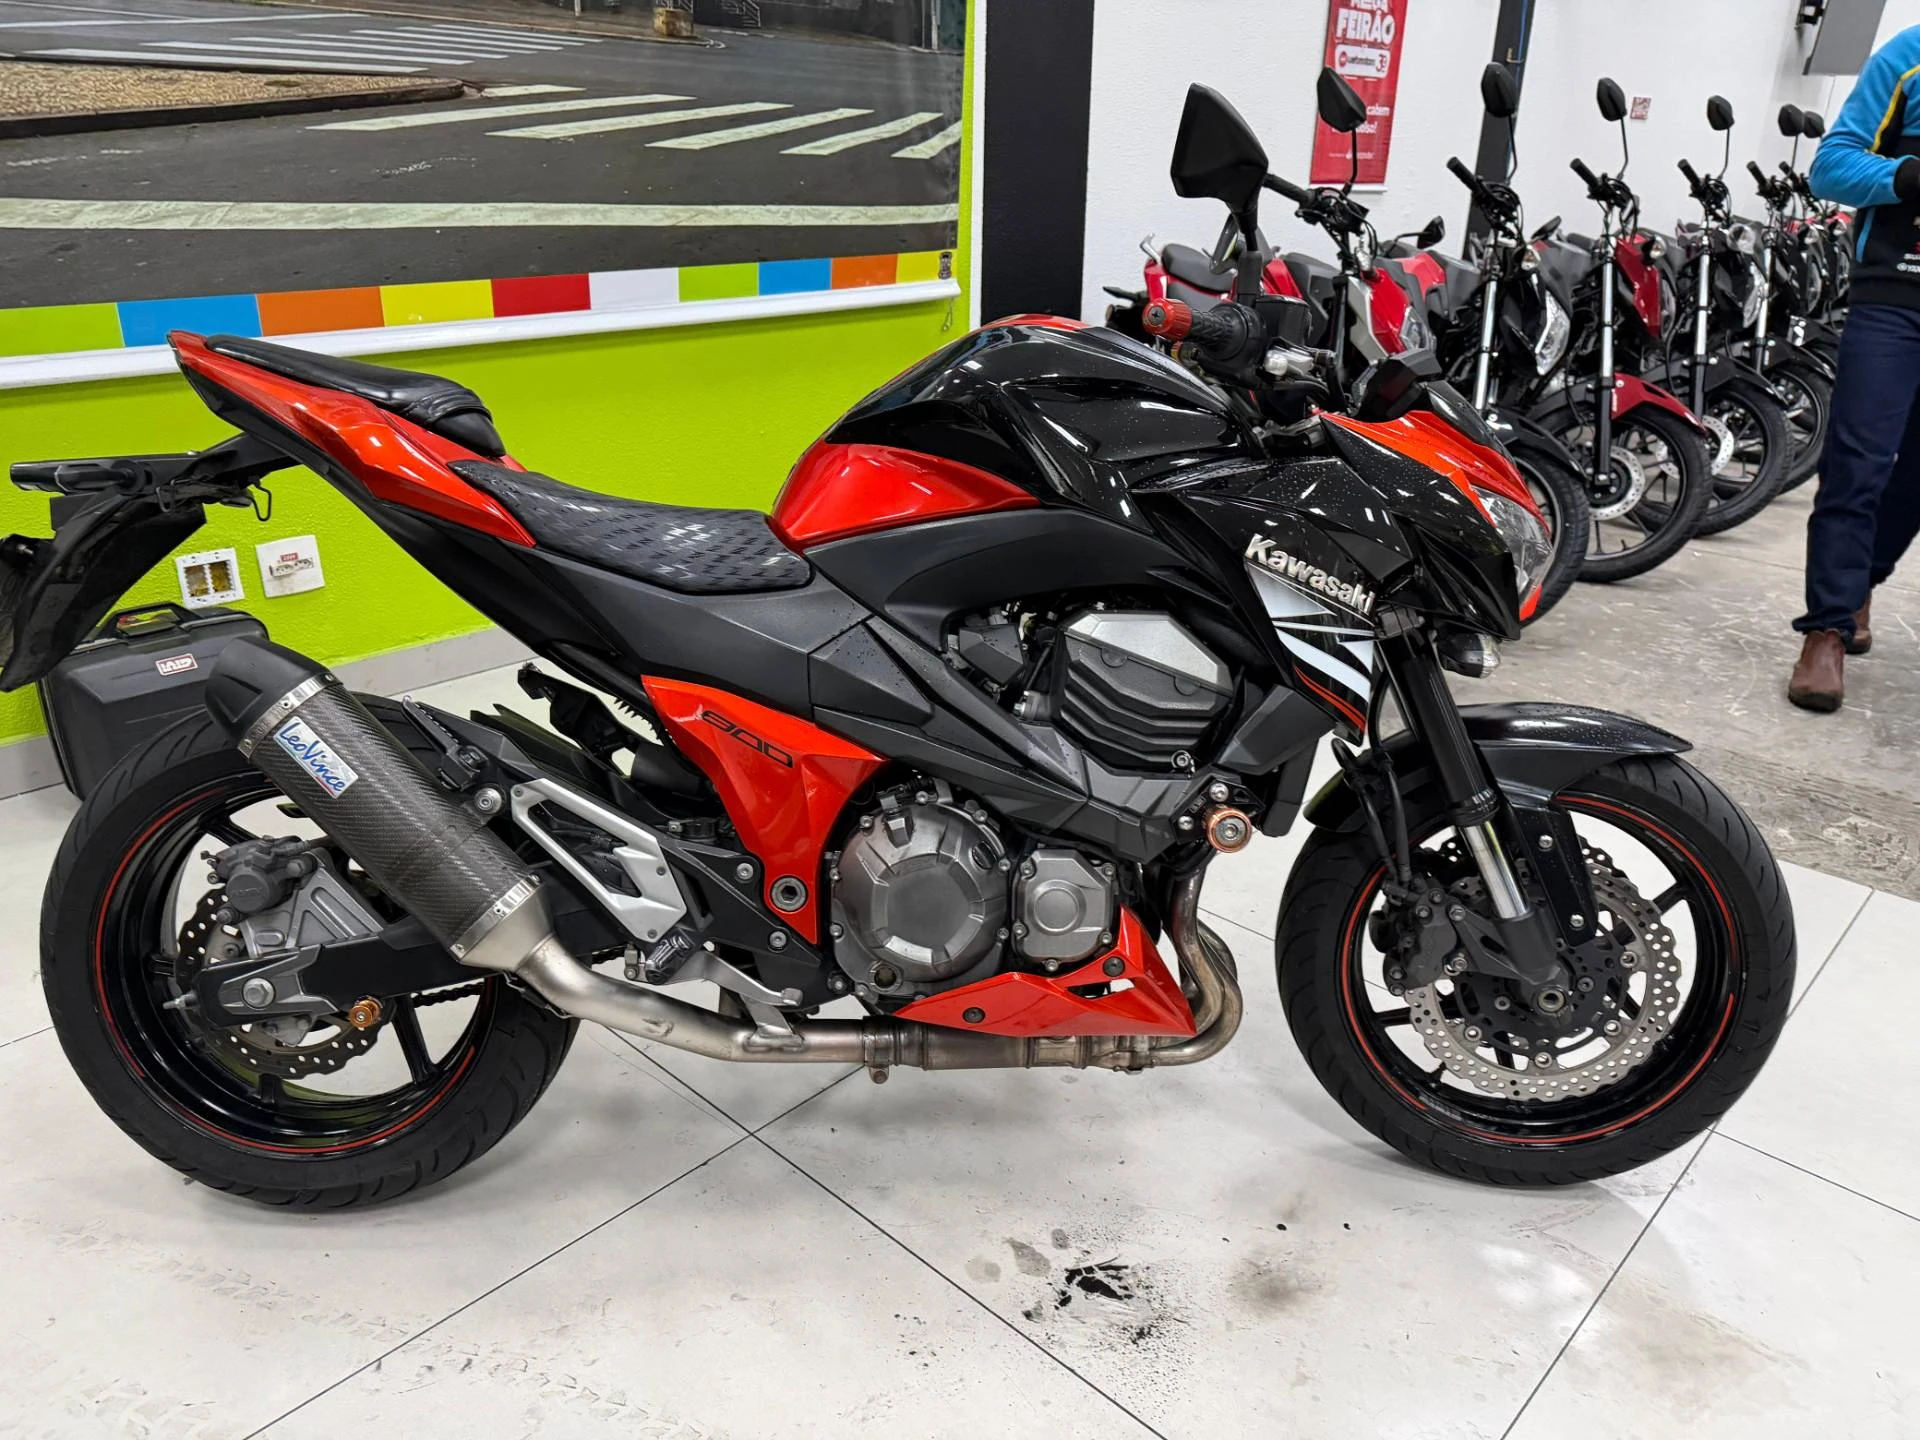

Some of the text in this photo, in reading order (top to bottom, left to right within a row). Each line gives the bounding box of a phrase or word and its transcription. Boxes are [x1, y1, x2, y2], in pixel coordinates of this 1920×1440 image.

[1336, 7, 1396, 45] FEIRÃO
[1244, 533, 1376, 616] Kawasaki
[279, 722, 346, 791] LeoVince
